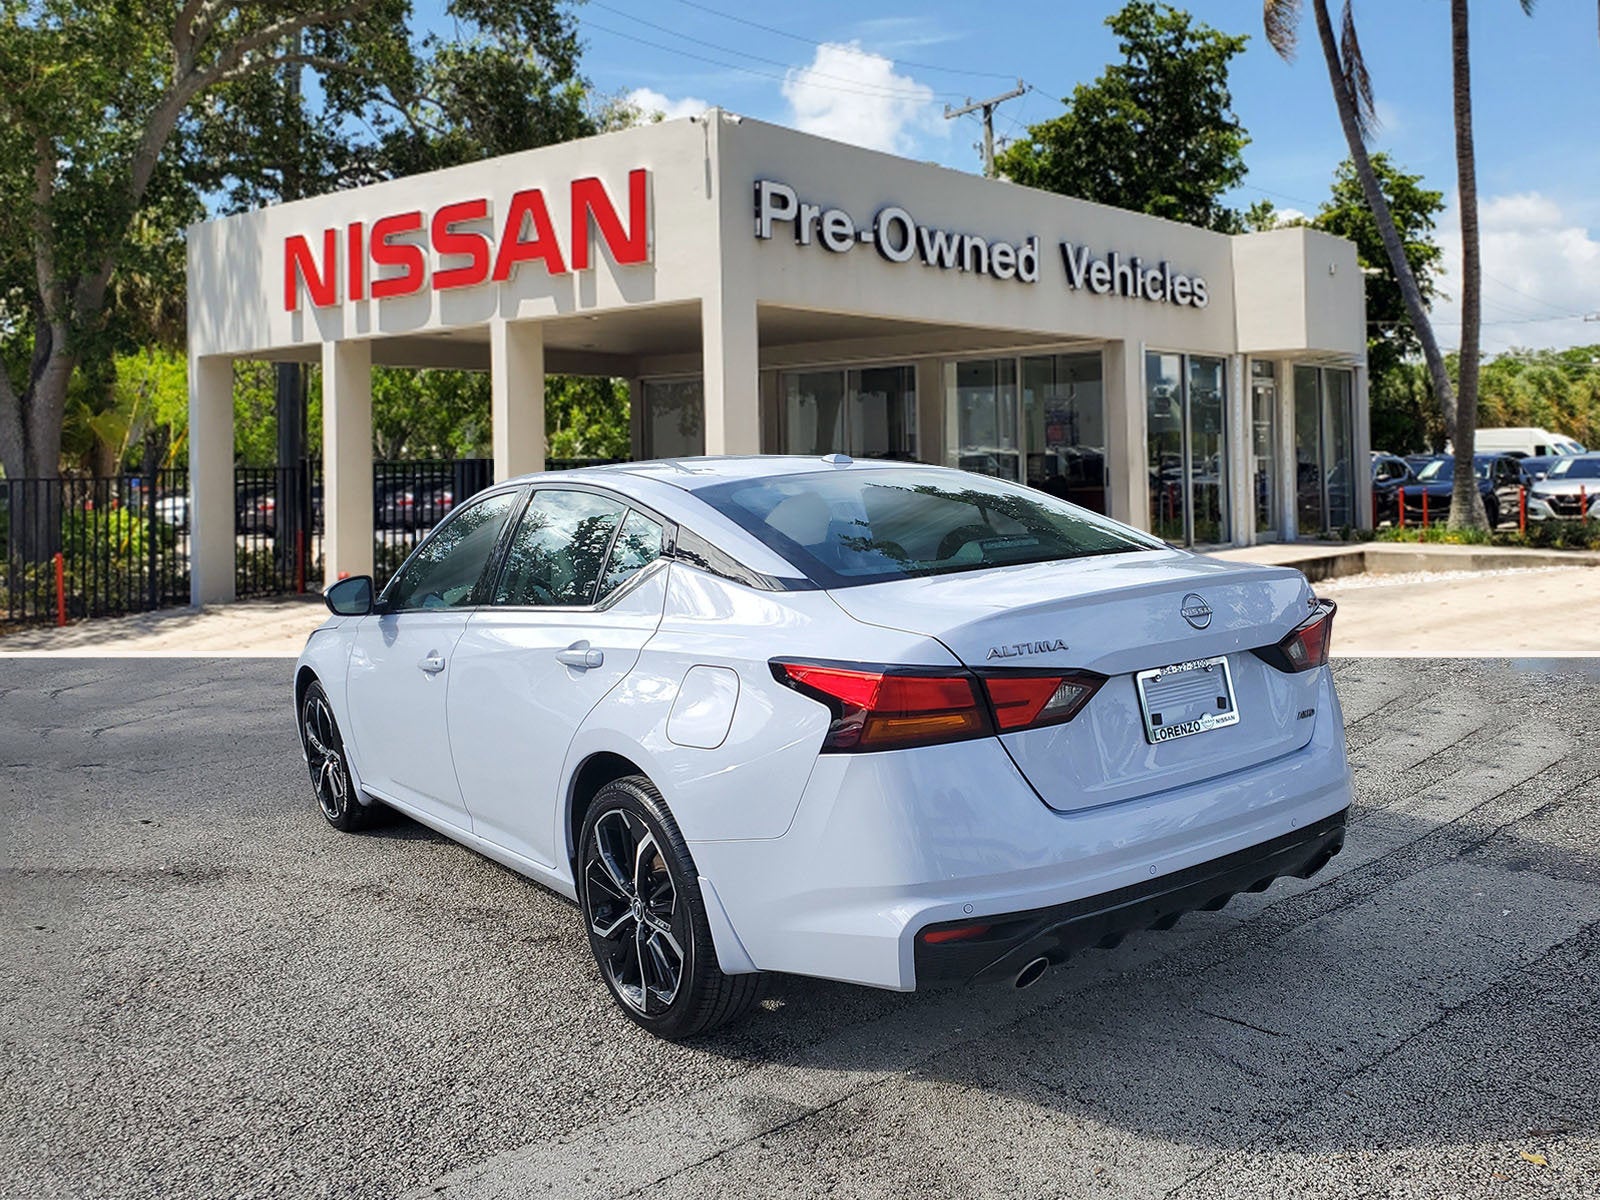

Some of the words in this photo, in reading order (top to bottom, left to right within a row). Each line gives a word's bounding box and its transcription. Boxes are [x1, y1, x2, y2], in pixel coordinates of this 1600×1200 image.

[285, 168, 647, 312] NISSAN
[754, 179, 1040, 283] Pre-Owned
[1060, 241, 1208, 308] Vehicles
[986, 639, 1069, 660] ALTIMA
[1153, 721, 1201, 742] LORENZO
